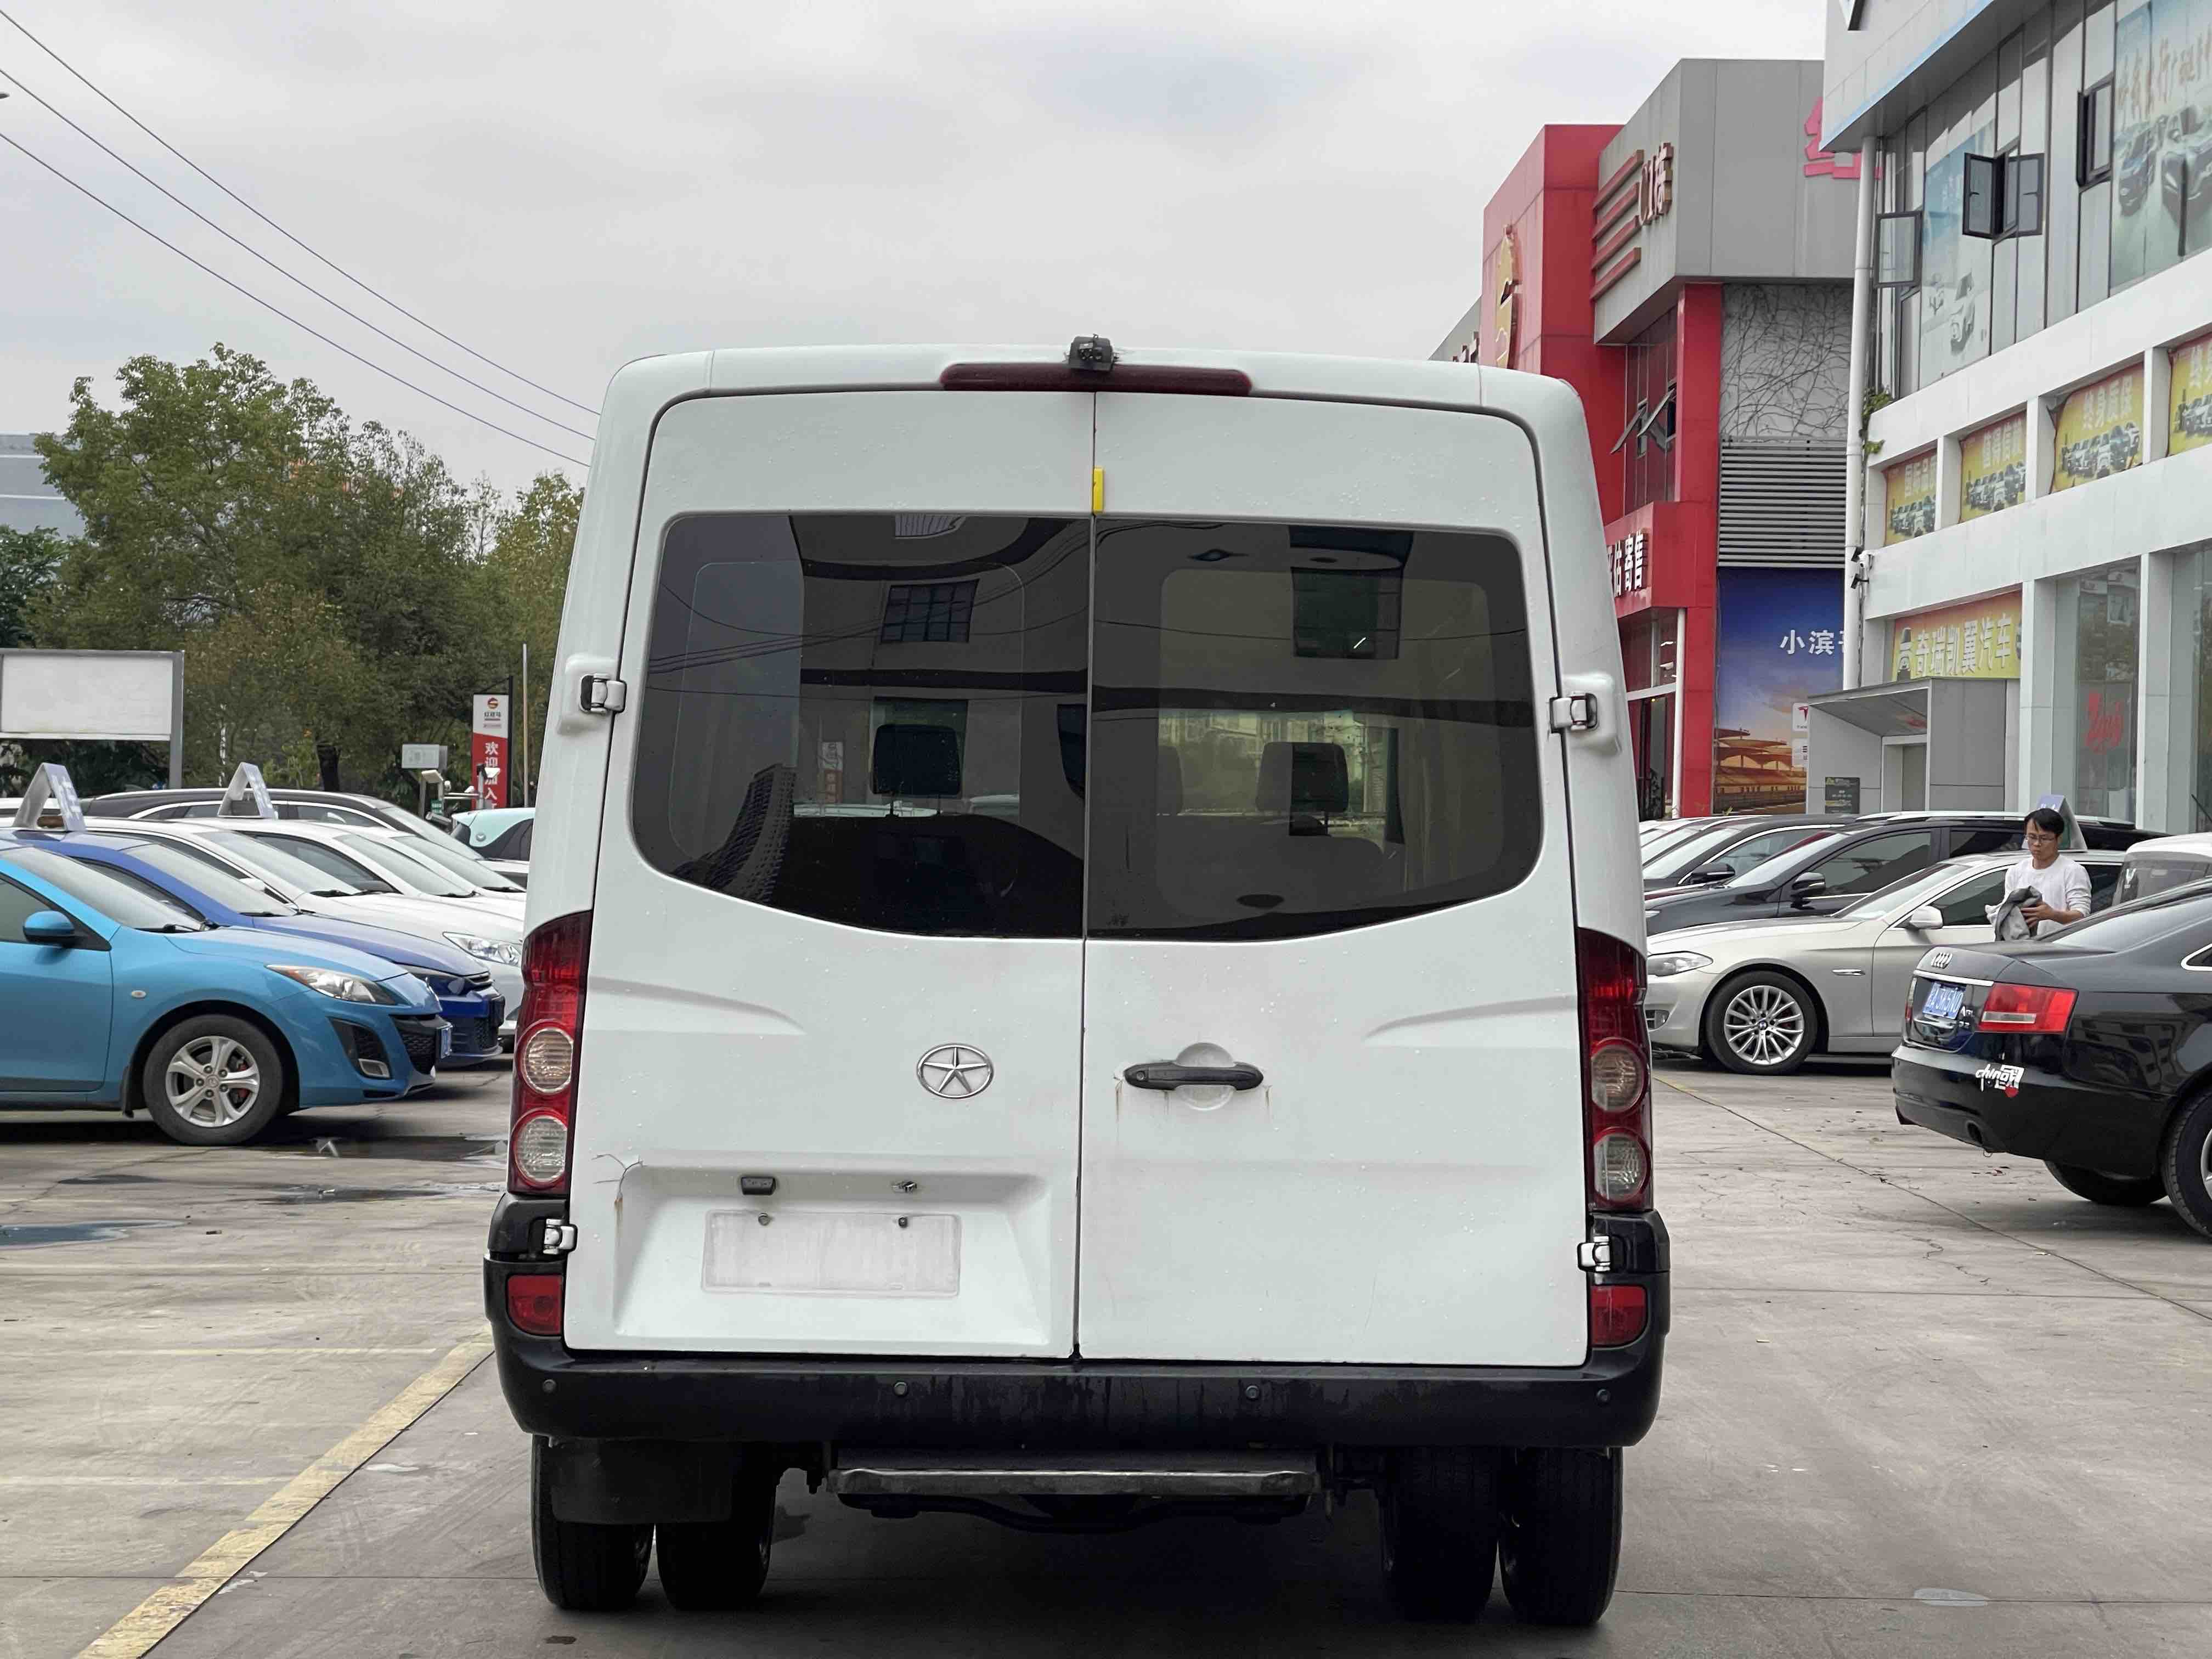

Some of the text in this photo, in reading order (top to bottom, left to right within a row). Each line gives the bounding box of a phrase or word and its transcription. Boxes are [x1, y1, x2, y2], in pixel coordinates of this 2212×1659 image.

[1780, 630, 1844, 654] 小滨
[1915, 613, 2012, 676] 奇瑞凯翼汽车
